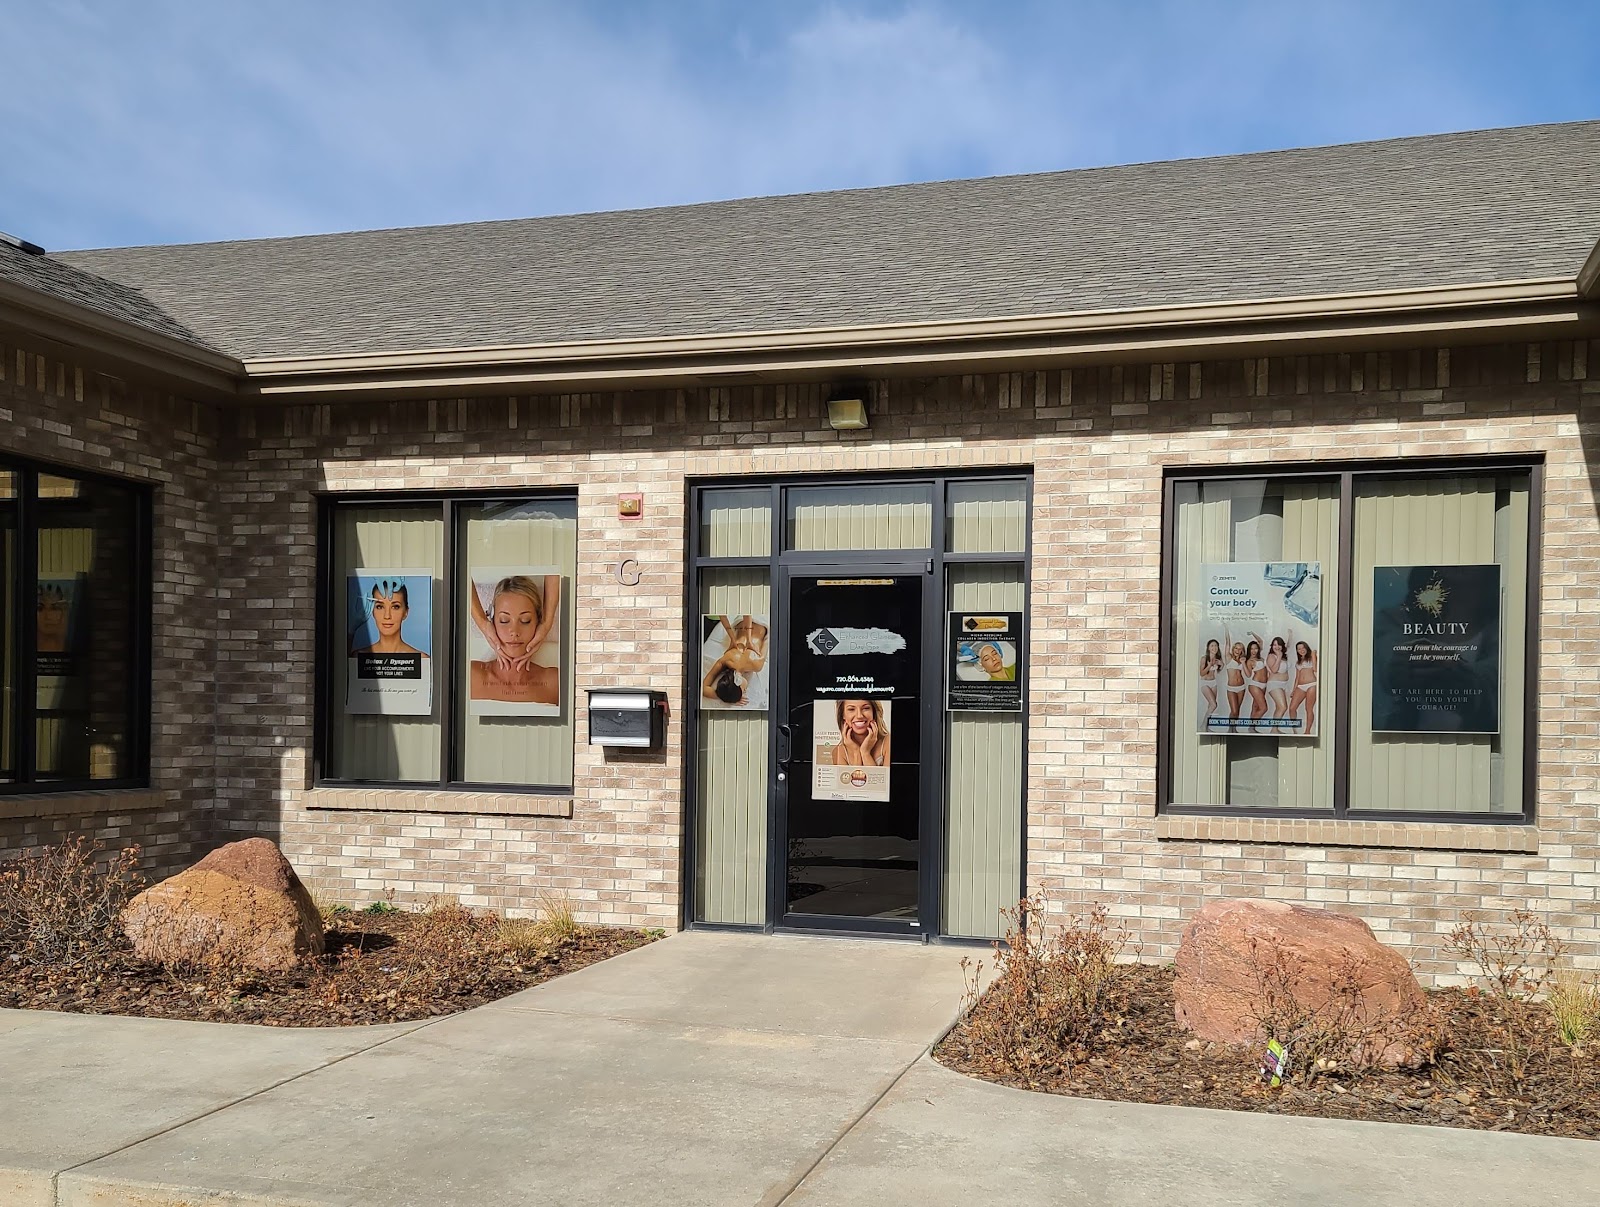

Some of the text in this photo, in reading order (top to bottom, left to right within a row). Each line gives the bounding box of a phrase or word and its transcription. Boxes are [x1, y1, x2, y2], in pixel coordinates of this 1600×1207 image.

[614, 559, 642, 586] G
[1210, 587, 1249, 595] Contour
[1210, 599, 1257, 608] your body
[1403, 623, 1469, 635] BEAUTY
[1413, 644, 1430, 652] from
[1409, 653, 1421, 661] just
[1432, 653, 1461, 661] yourself.
[390, 658, 414, 666] Dysport
